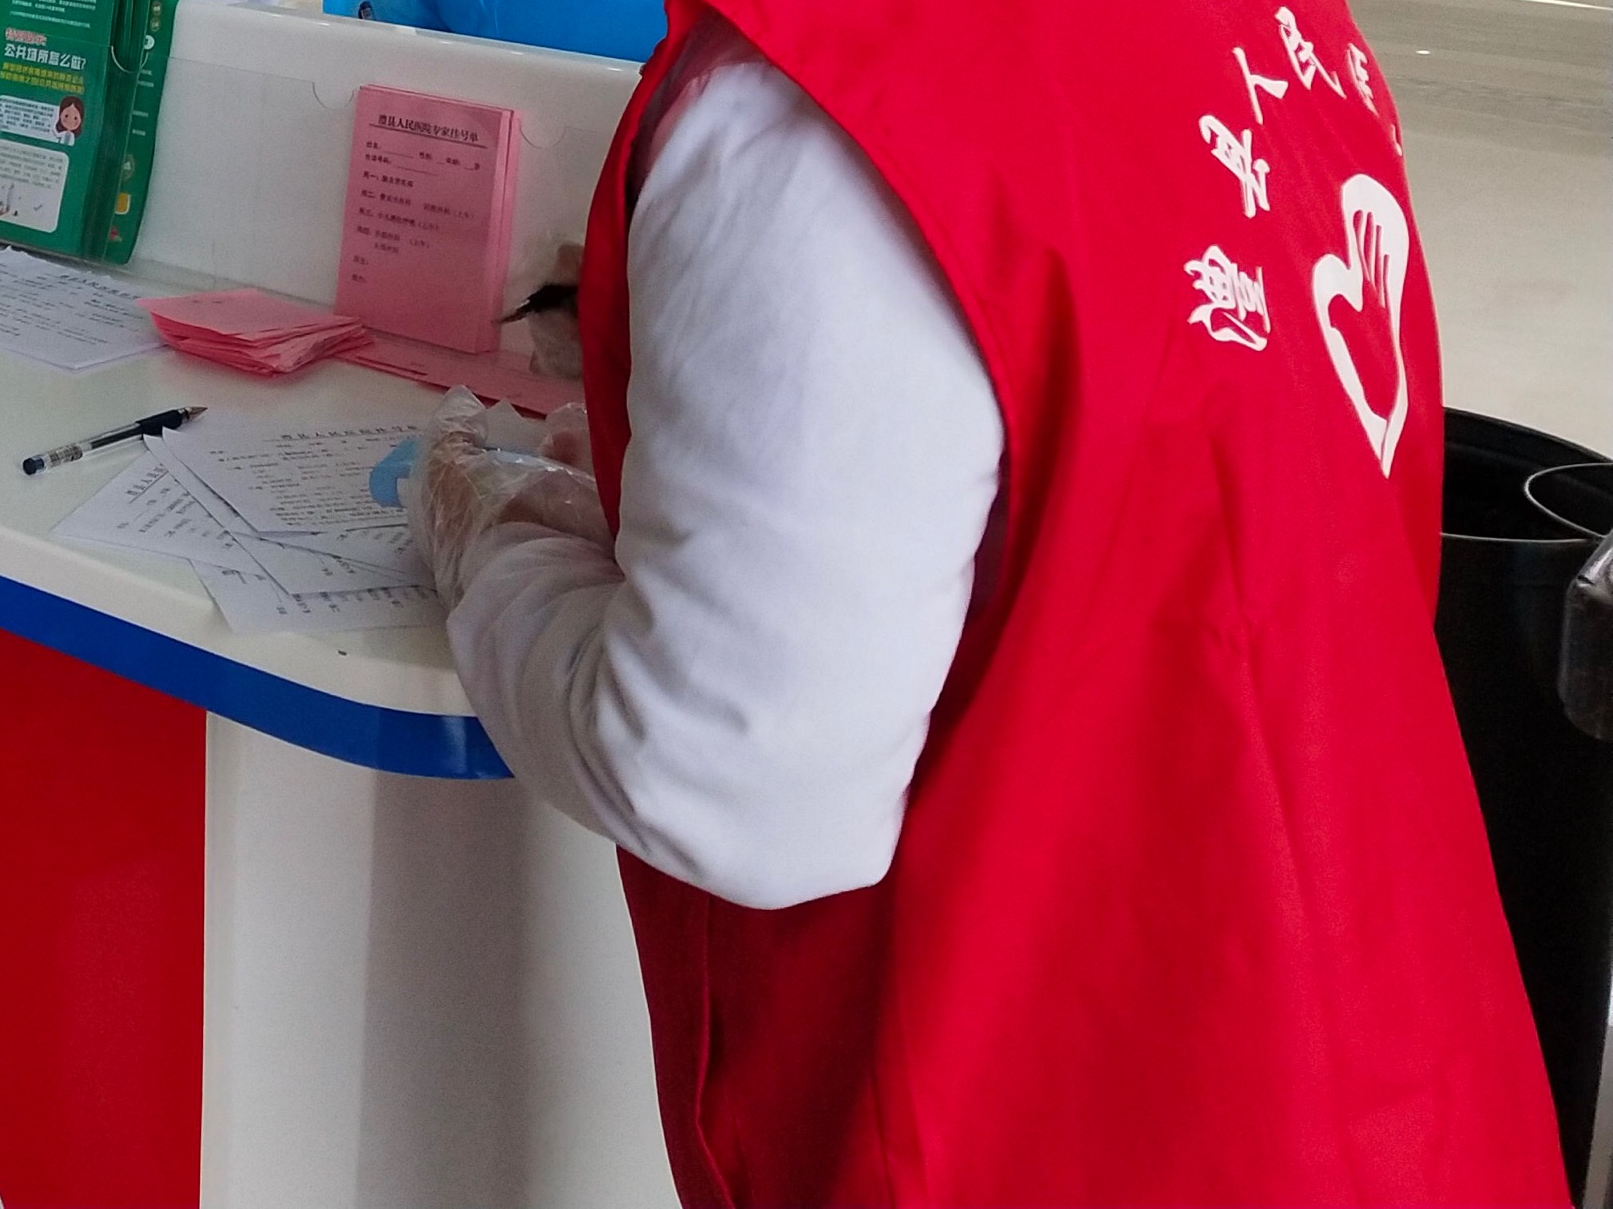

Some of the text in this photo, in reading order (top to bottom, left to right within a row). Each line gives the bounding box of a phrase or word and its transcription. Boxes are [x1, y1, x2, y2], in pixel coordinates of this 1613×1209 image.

[4, 43, 87, 70] 公共场所怎么做？
[1184, 6, 1403, 352] 澧县人民医
